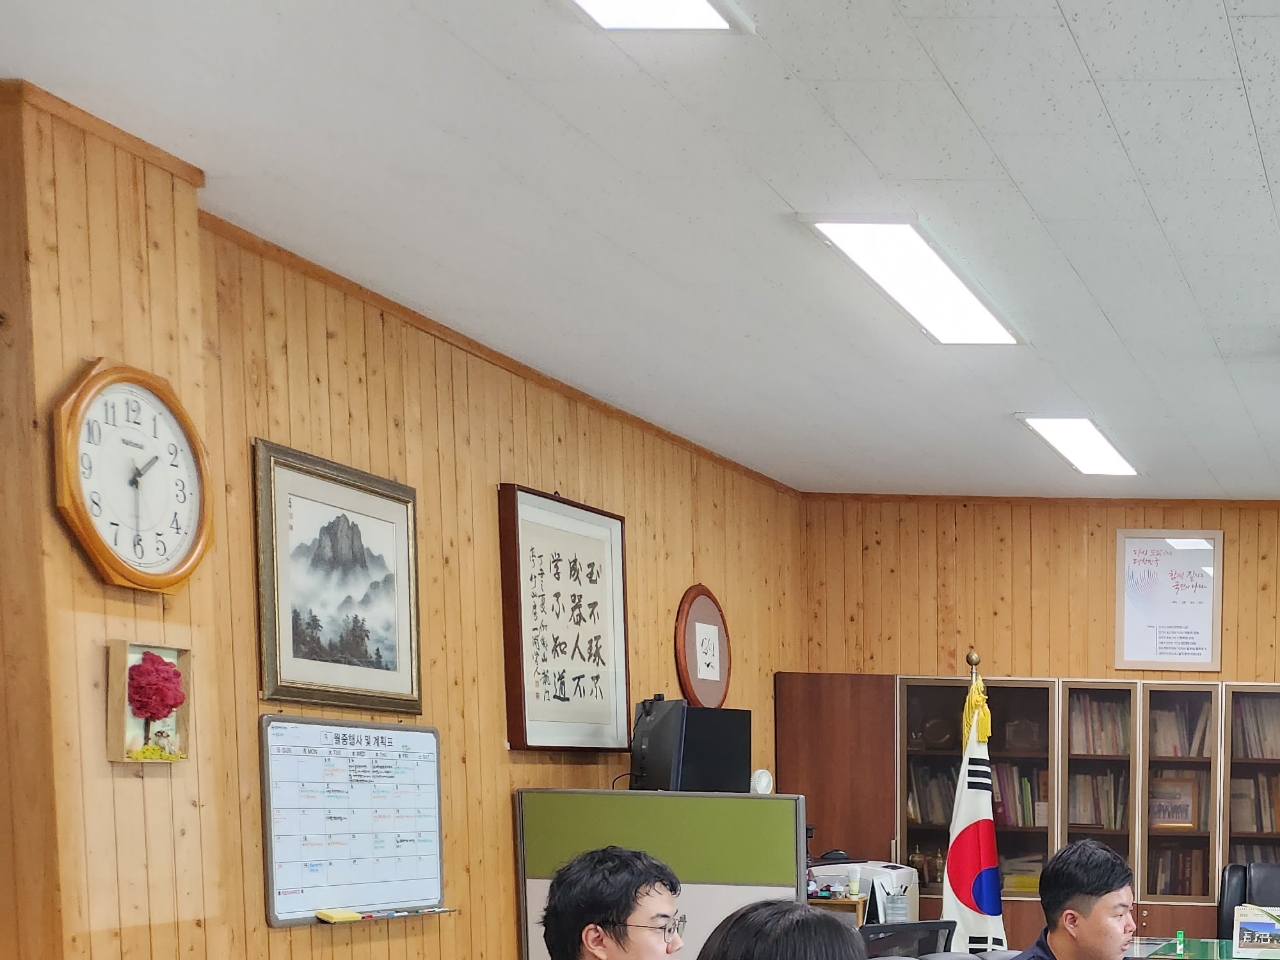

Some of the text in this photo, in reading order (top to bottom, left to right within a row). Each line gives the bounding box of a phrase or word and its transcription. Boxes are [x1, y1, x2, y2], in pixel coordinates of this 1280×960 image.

[103, 399, 118, 427] 11
[124, 398, 141, 425] 12
[86, 418, 102, 446] 10
[151, 413, 159, 439] 1
[80, 453, 93, 480] 9
[167, 443, 179, 468] 2
[89, 491, 102, 517] 8
[175, 478, 187, 504] 3
[109, 521, 120, 547] 7
[169, 512, 181, 535] 4
[132, 534, 145, 560] 6
[155, 532, 167, 557] 5
[333, 732, 363, 747] 월중행사
[364, 735, 372, 747] 및
[373, 735, 394, 748] 계획표
